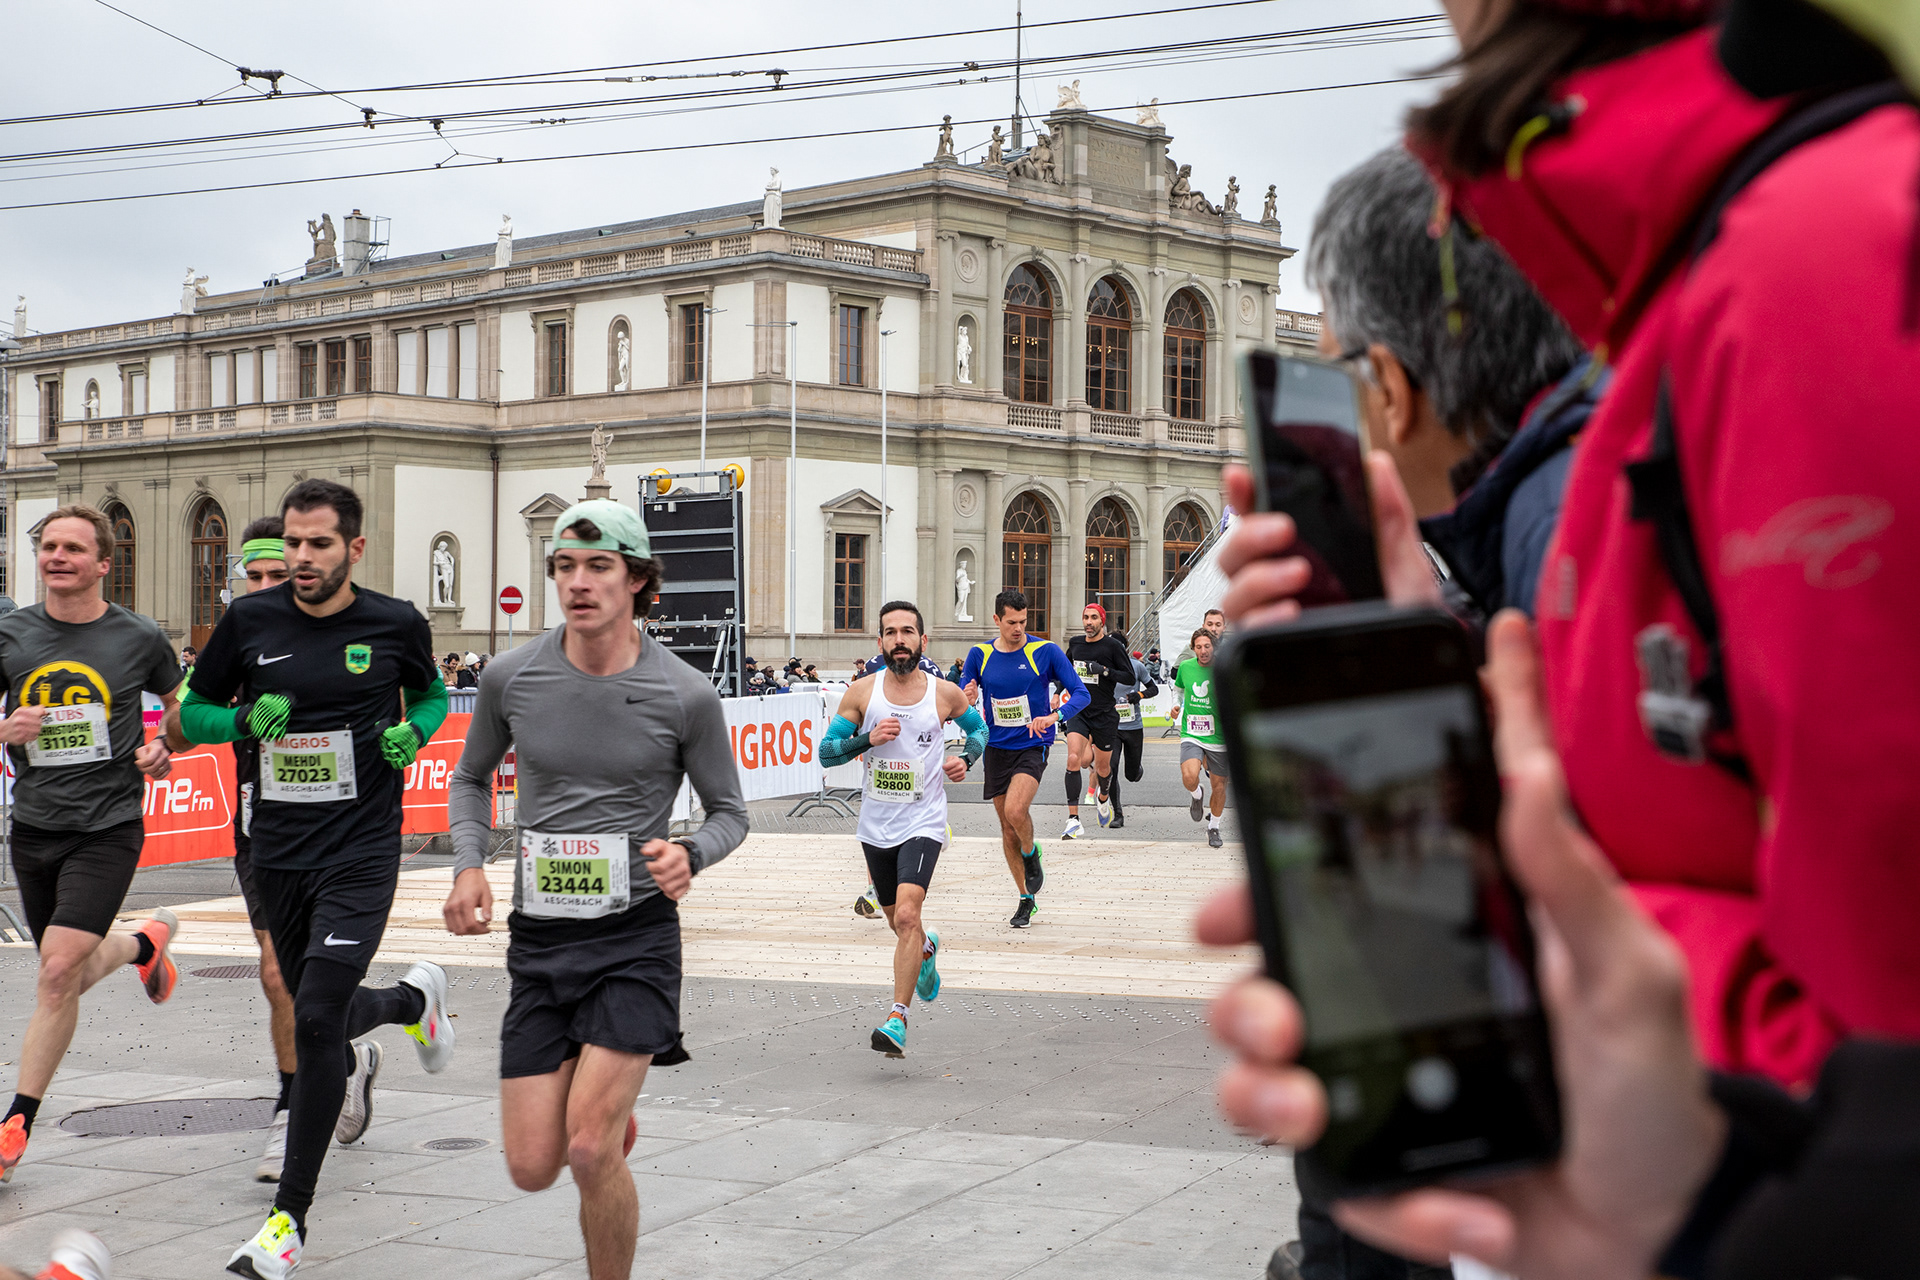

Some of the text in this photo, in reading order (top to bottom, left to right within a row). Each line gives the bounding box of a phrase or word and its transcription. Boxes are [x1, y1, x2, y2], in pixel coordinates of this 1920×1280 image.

[54, 708, 84, 722] UBS
[42, 734, 88, 750] 31192
[274, 736, 330, 749] MIGROS
[730, 719, 813, 770] IGROS
[284, 755, 321, 768] MEHDI
[889, 762, 910, 770] UBS
[277, 768, 330, 783] 27023
[878, 771, 909, 780] RICARDO
[280, 784, 332, 793] AESCHBACH
[876, 779, 911, 790] 29800
[562, 840, 600, 855] UBS
[549, 861, 591, 874] SIMON
[541, 876, 604, 893] 23444
[544, 897, 602, 906] AESCHBACH
